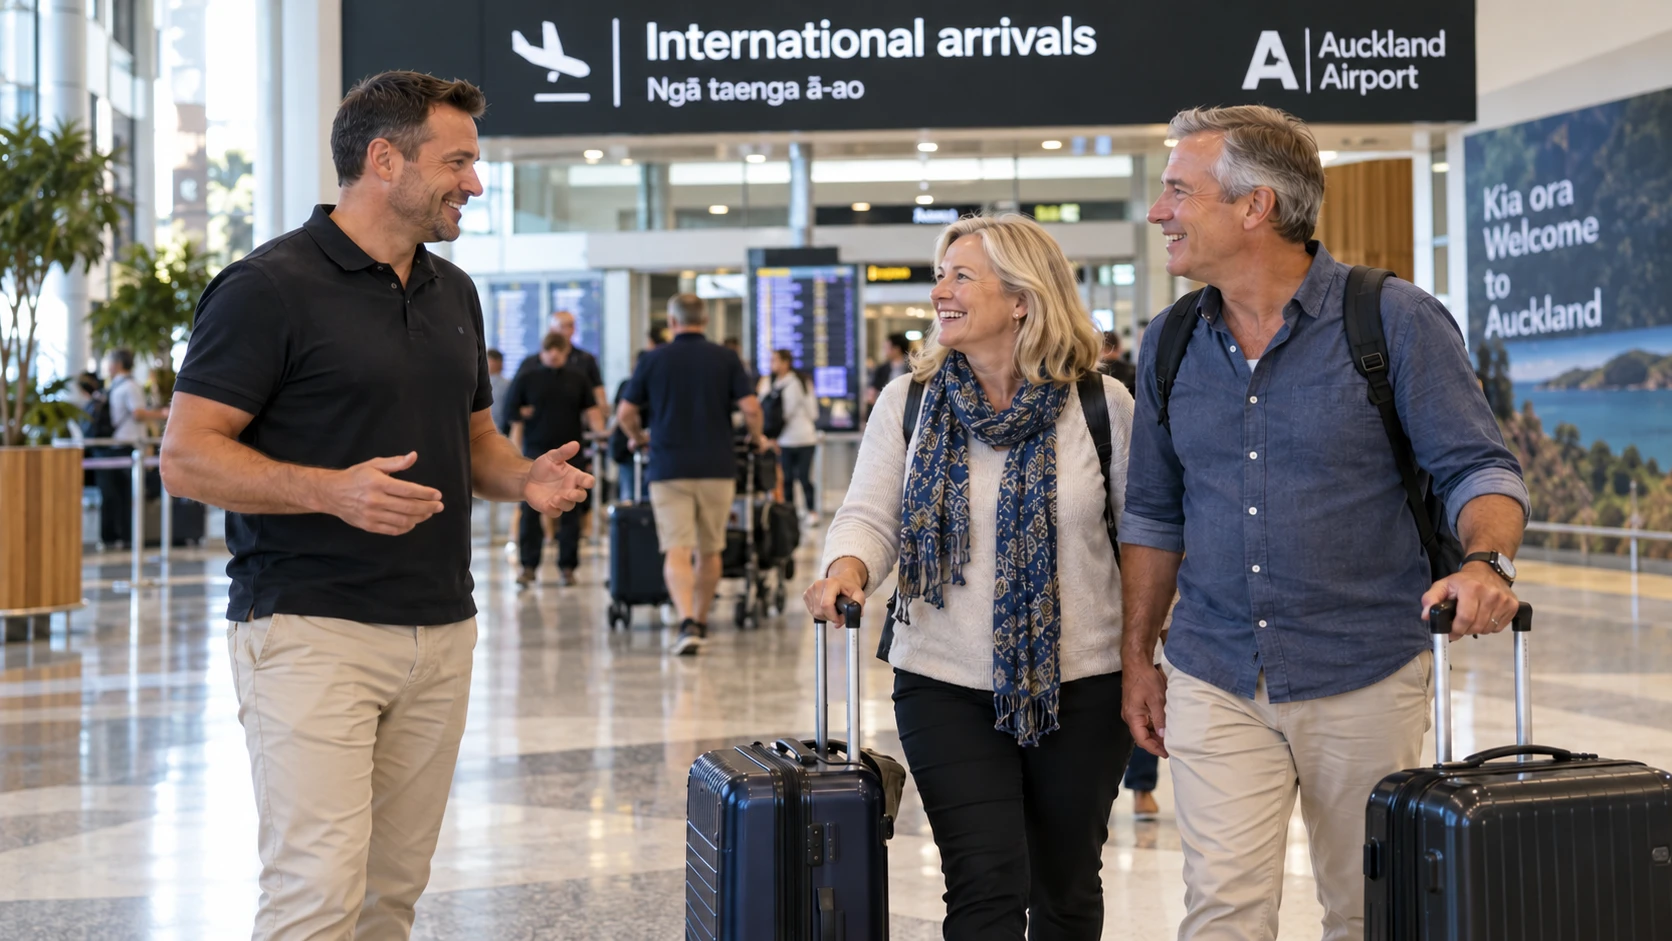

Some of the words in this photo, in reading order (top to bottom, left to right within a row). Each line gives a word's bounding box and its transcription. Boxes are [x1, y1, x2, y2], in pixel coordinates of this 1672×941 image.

[646, 18, 925, 61] International
[936, 15, 1097, 59] arrivals
[1318, 29, 1446, 59] Auckland
[707, 77, 800, 107] taenga
[1319, 62, 1419, 96] Airport
[1483, 184, 1523, 222] Kia
[1529, 180, 1574, 212] ora
[1483, 216, 1600, 261] Welcome
[1484, 268, 1511, 300] to
[1484, 286, 1602, 339] Auckland
